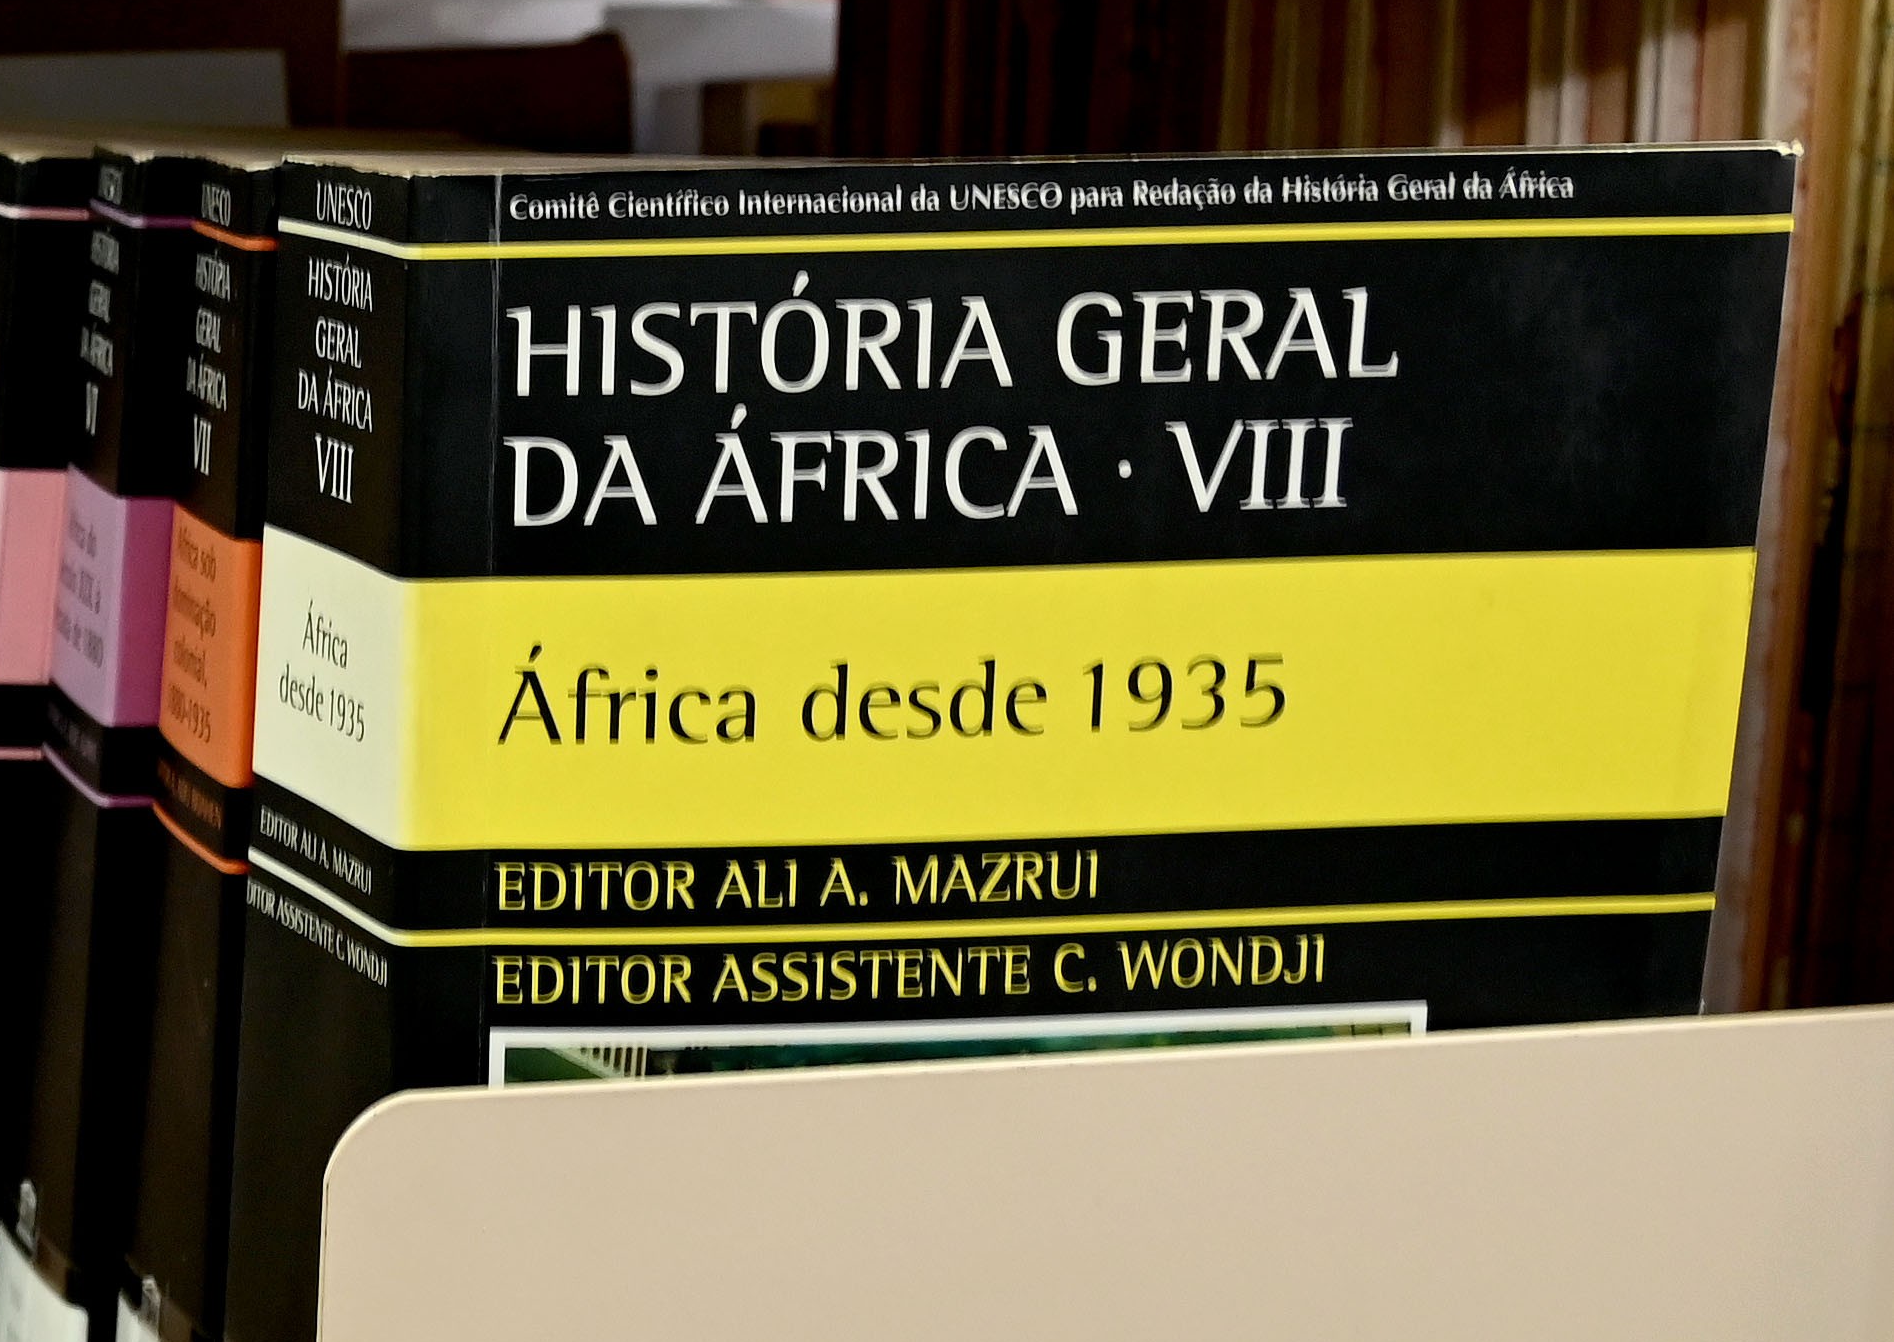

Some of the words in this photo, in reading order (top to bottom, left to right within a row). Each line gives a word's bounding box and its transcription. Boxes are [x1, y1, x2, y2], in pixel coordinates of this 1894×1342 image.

[201, 179, 232, 228] UNESCO
[315, 179, 373, 232] UNESCO
[509, 190, 601, 222] Comitê
[607, 187, 731, 220] Científico
[738, 183, 903, 217] Internacional
[910, 183, 941, 213] da
[949, 181, 1063, 211] UNESCO
[1070, 183, 1125, 216] para
[1132, 177, 1237, 212] Redação
[1243, 175, 1274, 205] da
[1281, 172, 1380, 205] História
[1387, 171, 1457, 202] Geral
[1462, 169, 1493, 200] da
[1498, 165, 1576, 200] África
[195, 249, 231, 302] HISTÓRIA
[307, 249, 374, 313] HISTÓRIA
[195, 305, 222, 354] GERAL
[315, 315, 362, 370] GERAL
[505, 269, 1015, 399] HISTÓRIA
[1054, 284, 1402, 388] GERAL
[197, 353, 227, 411] ÁFRICA
[297, 367, 319, 415] DA
[322, 364, 374, 434] ÁFRICA
[193, 413, 212, 477] VII
[314, 432, 355, 505] VIII
[505, 430, 659, 529] DA
[694, 401, 1080, 526] ÁFRICA
[1165, 415, 1355, 515] VIII
[301, 600, 349, 670] África
[278, 663, 324, 724] desde
[328, 687, 366, 744] 1935
[497, 644, 758, 748] África
[799, 655, 1050, 744] desde
[1080, 651, 1289, 735] 1935
[259, 804, 299, 853] EDITOR
[299, 832, 319, 865] ALI
[332, 845, 373, 898] MAZRUI
[494, 859, 697, 914] EDITOR
[714, 858, 799, 911] ALI
[818, 856, 869, 909] A.
[893, 848, 1100, 908] MAZRUI
[246, 874, 277, 920] DITOR
[276, 891, 335, 957] ASSISTENTE
[346, 935, 389, 990] WONDJI
[492, 953, 694, 1007] EDITOR
[710, 944, 1031, 1006] ASSISTENTE
[1052, 941, 1099, 995] C.
[1115, 932, 1328, 990] WONDJI
